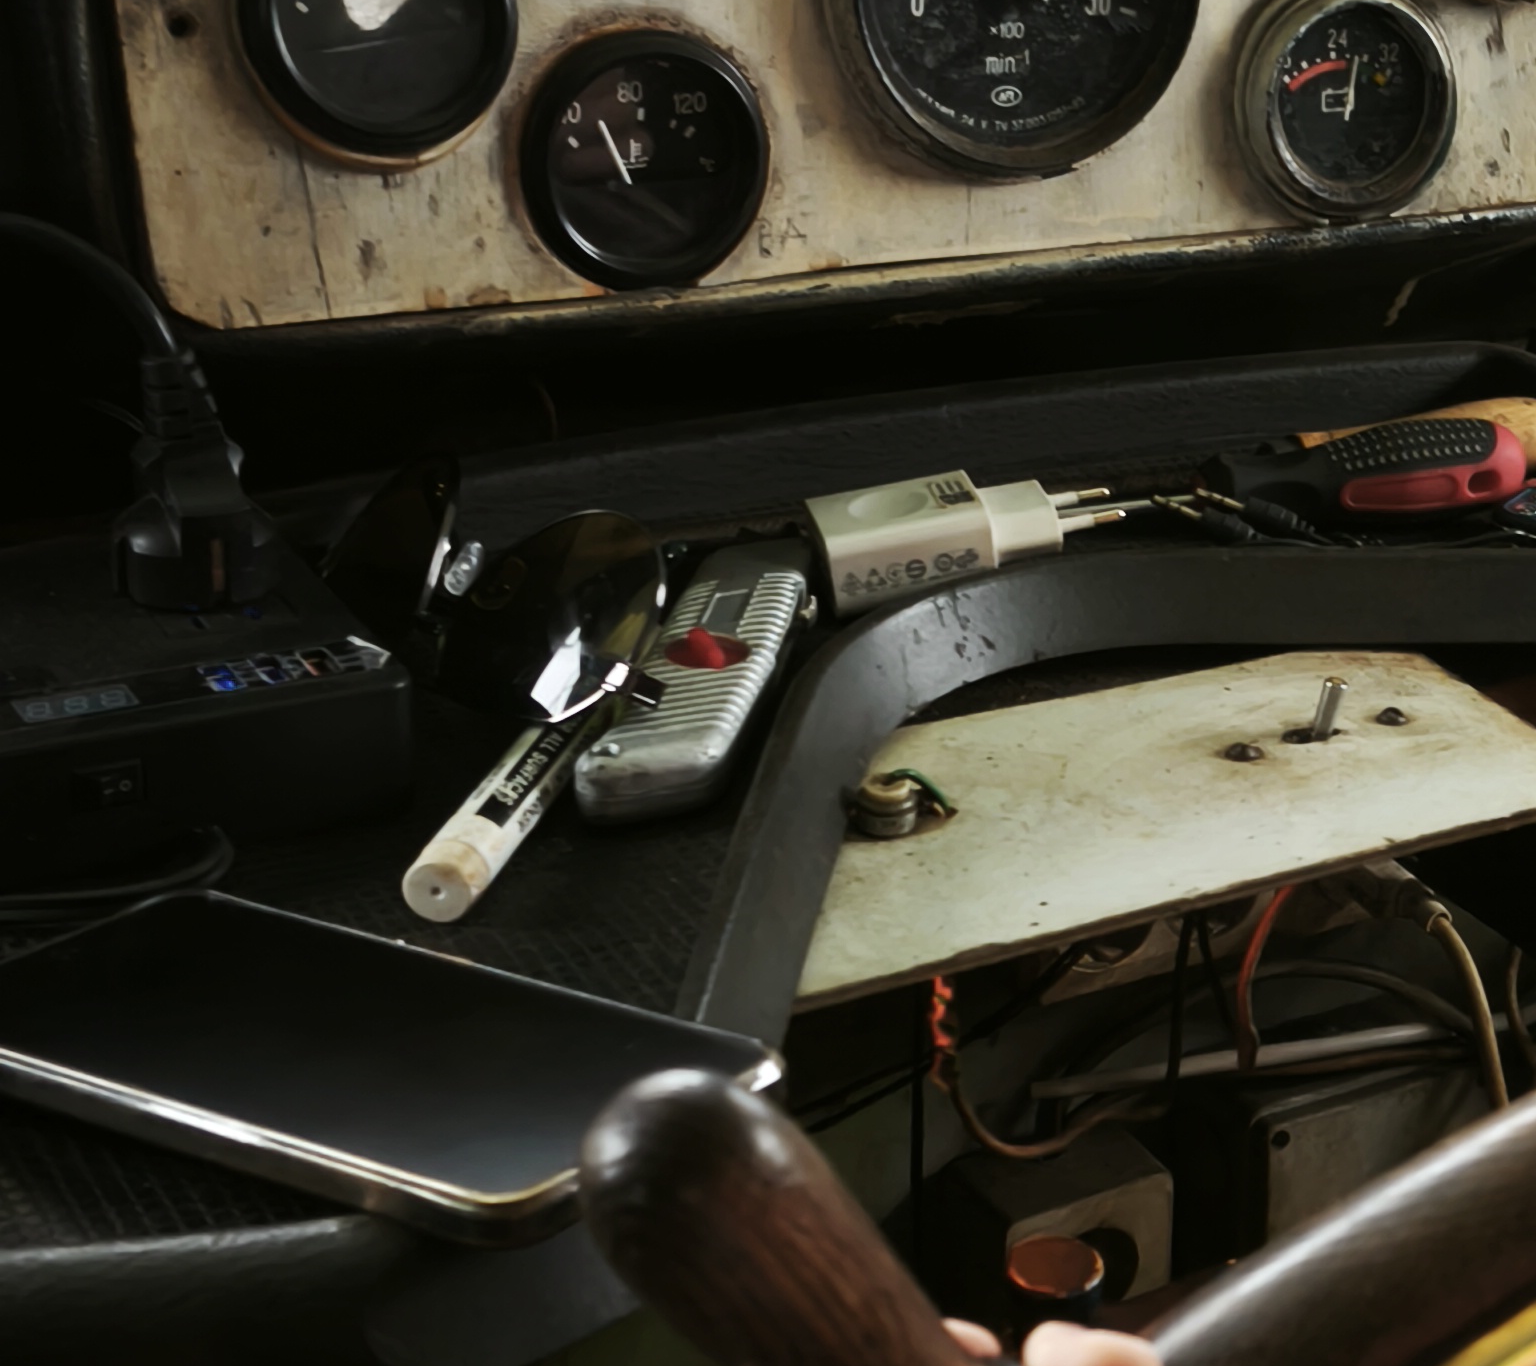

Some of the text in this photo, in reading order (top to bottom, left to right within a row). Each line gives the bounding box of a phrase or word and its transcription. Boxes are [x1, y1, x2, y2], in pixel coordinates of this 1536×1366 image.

[1327, 28, 1401, 63] 24 32
[616, 81, 644, 104] 80
[672, 91, 708, 115] 120
[539, 730, 565, 753] ALL
